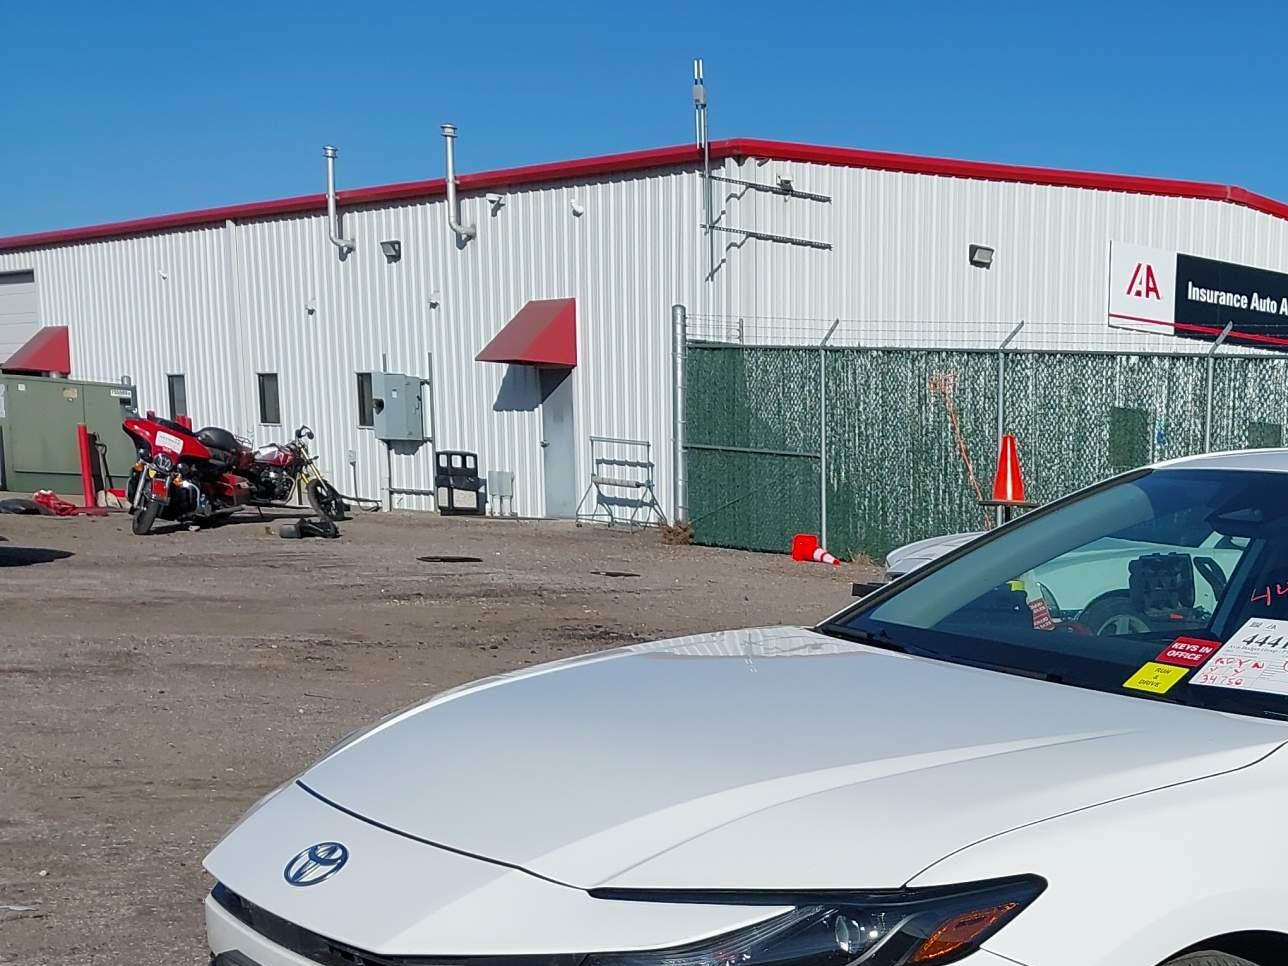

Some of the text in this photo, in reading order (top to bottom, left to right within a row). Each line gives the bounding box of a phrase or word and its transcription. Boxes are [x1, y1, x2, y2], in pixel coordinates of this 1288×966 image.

[1187, 281, 1248, 309] Insurance
[1250, 292, 1278, 314] Auto
[1171, 642, 1213, 654] KEYS IN
[1166, 650, 1203, 661] OFFICE
